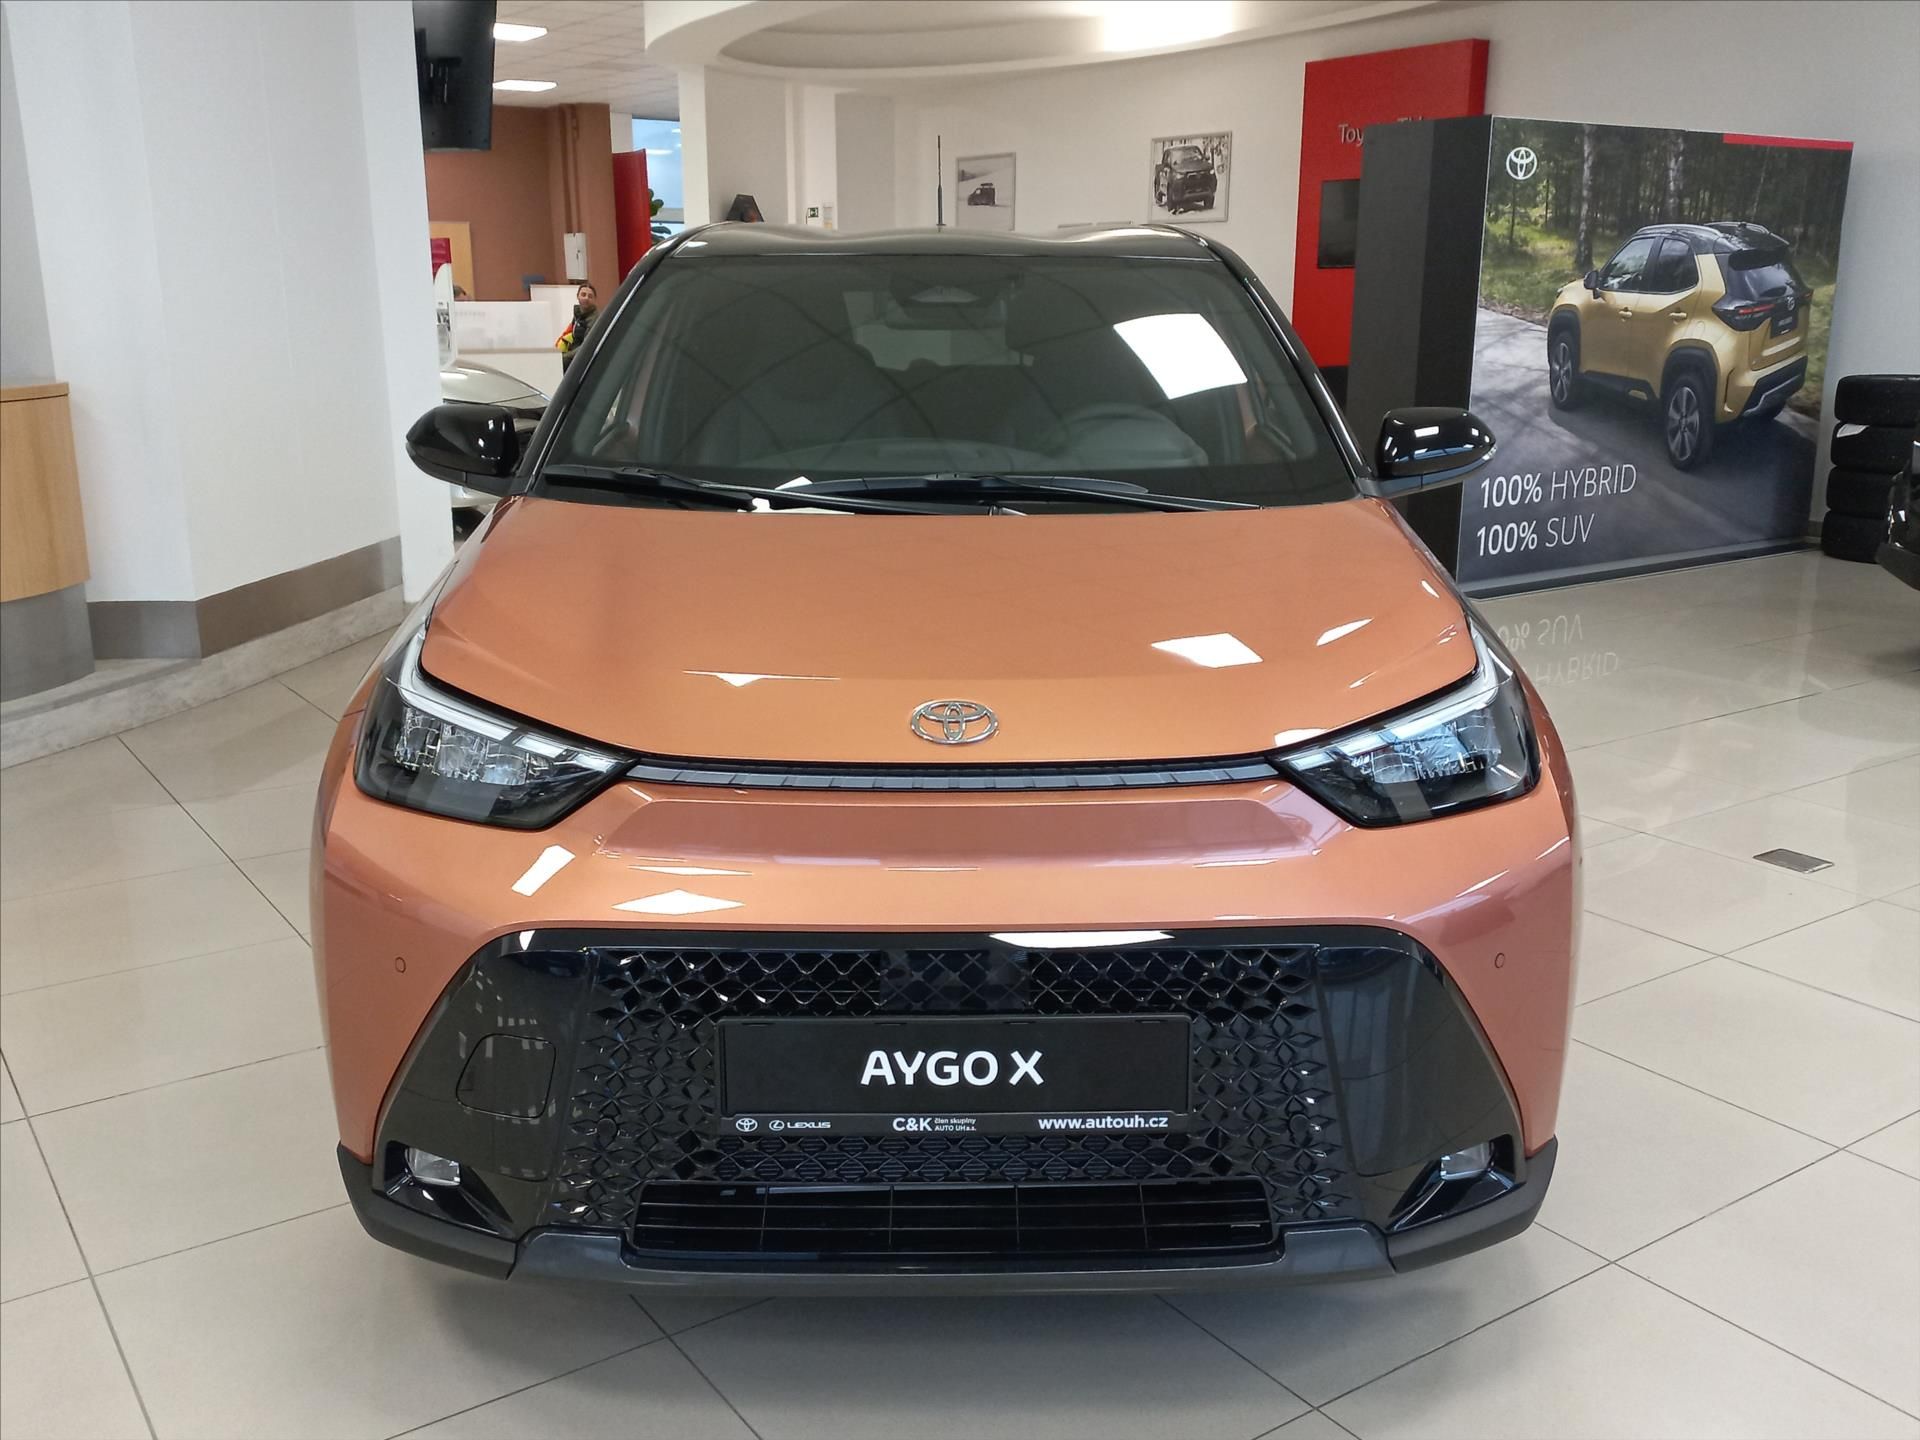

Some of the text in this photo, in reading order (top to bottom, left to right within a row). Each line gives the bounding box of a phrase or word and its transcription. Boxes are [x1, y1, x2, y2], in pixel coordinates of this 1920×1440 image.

[1338, 123, 1364, 147] Toy
[1481, 464, 1637, 508] 100% HYBRID
[1477, 513, 1595, 556] 100% SUV
[860, 1050, 1045, 1086] AYGO X
[787, 1121, 831, 1129] LEXUS
[892, 1117, 933, 1131] C&K
[1038, 1115, 1168, 1129] www.autouh.cz
